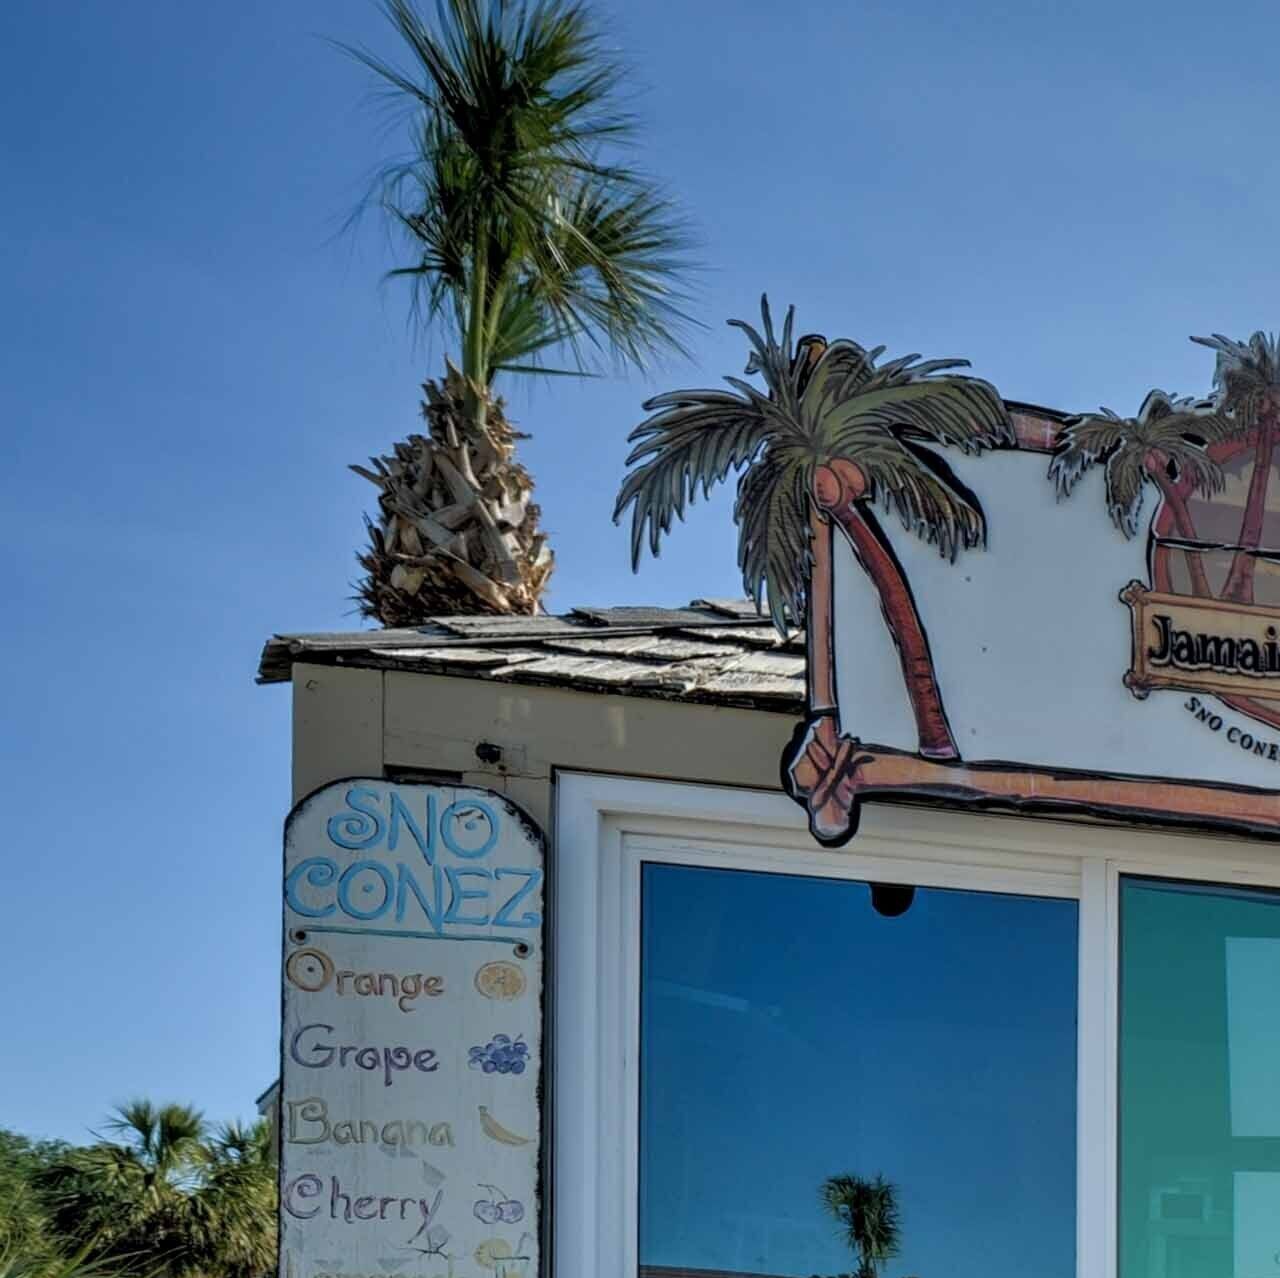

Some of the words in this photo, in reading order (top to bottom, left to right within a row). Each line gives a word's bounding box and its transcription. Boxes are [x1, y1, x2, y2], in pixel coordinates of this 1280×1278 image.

[1184, 696, 1223, 732] SNO
[327, 787, 498, 865] SNO
[286, 857, 541, 934] CONEZ
[286, 948, 445, 1012] Orange
[290, 1024, 440, 1087] Grape
[287, 1097, 455, 1147] Banana
[283, 1173, 442, 1244] Cherry
